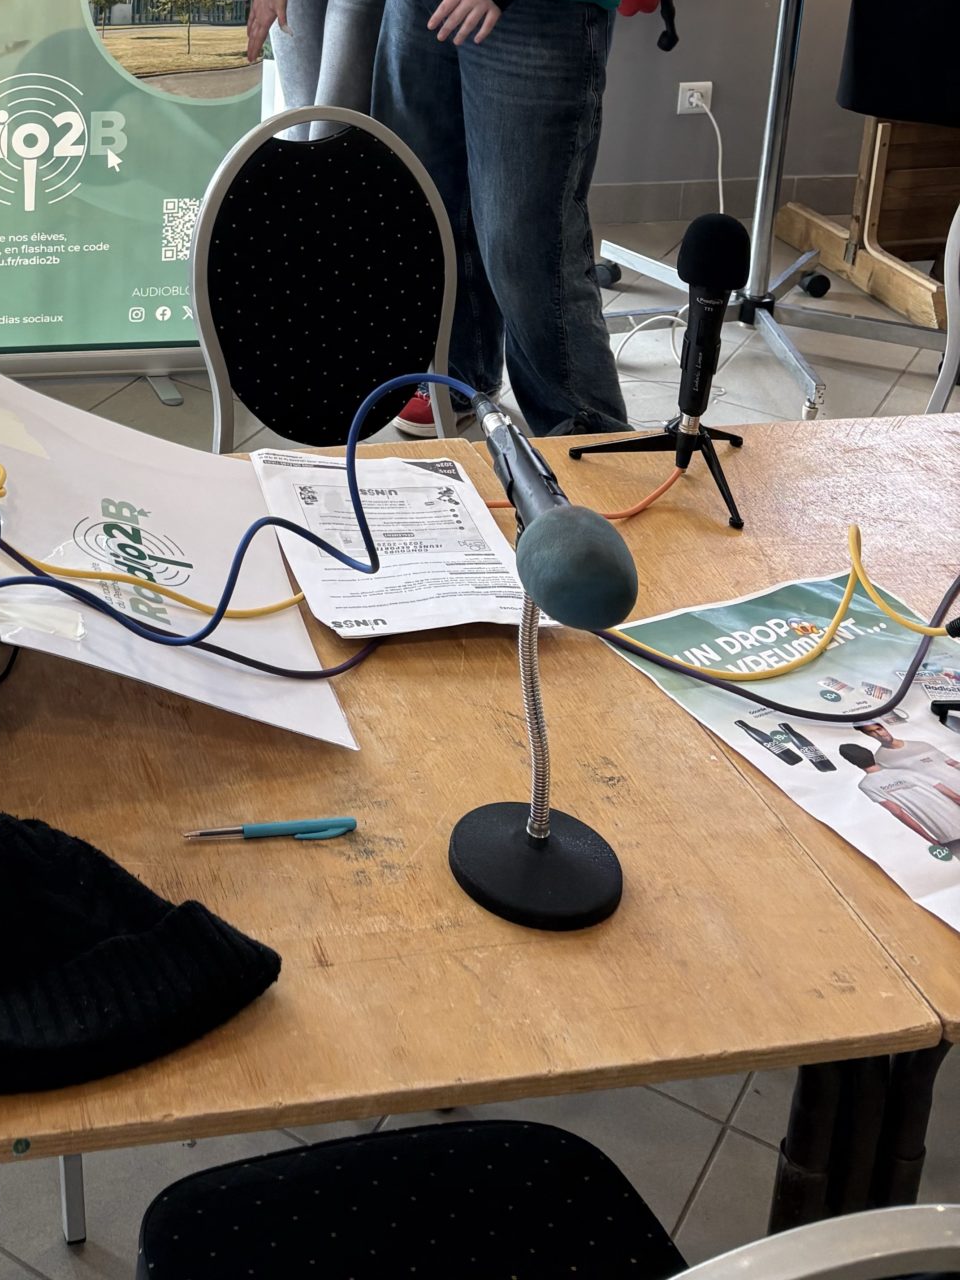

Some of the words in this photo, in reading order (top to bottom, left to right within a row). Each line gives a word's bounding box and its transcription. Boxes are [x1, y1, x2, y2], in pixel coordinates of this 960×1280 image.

[8, 235, 28, 243] nos
[30, 232, 68, 242] élèves,
[22, 244, 65, 254] flashant
[83, 242, 110, 252] code
[22, 314, 64, 324] sociaux
[674, 643, 722, 668] UN
[714, 618, 791, 656] DROP
